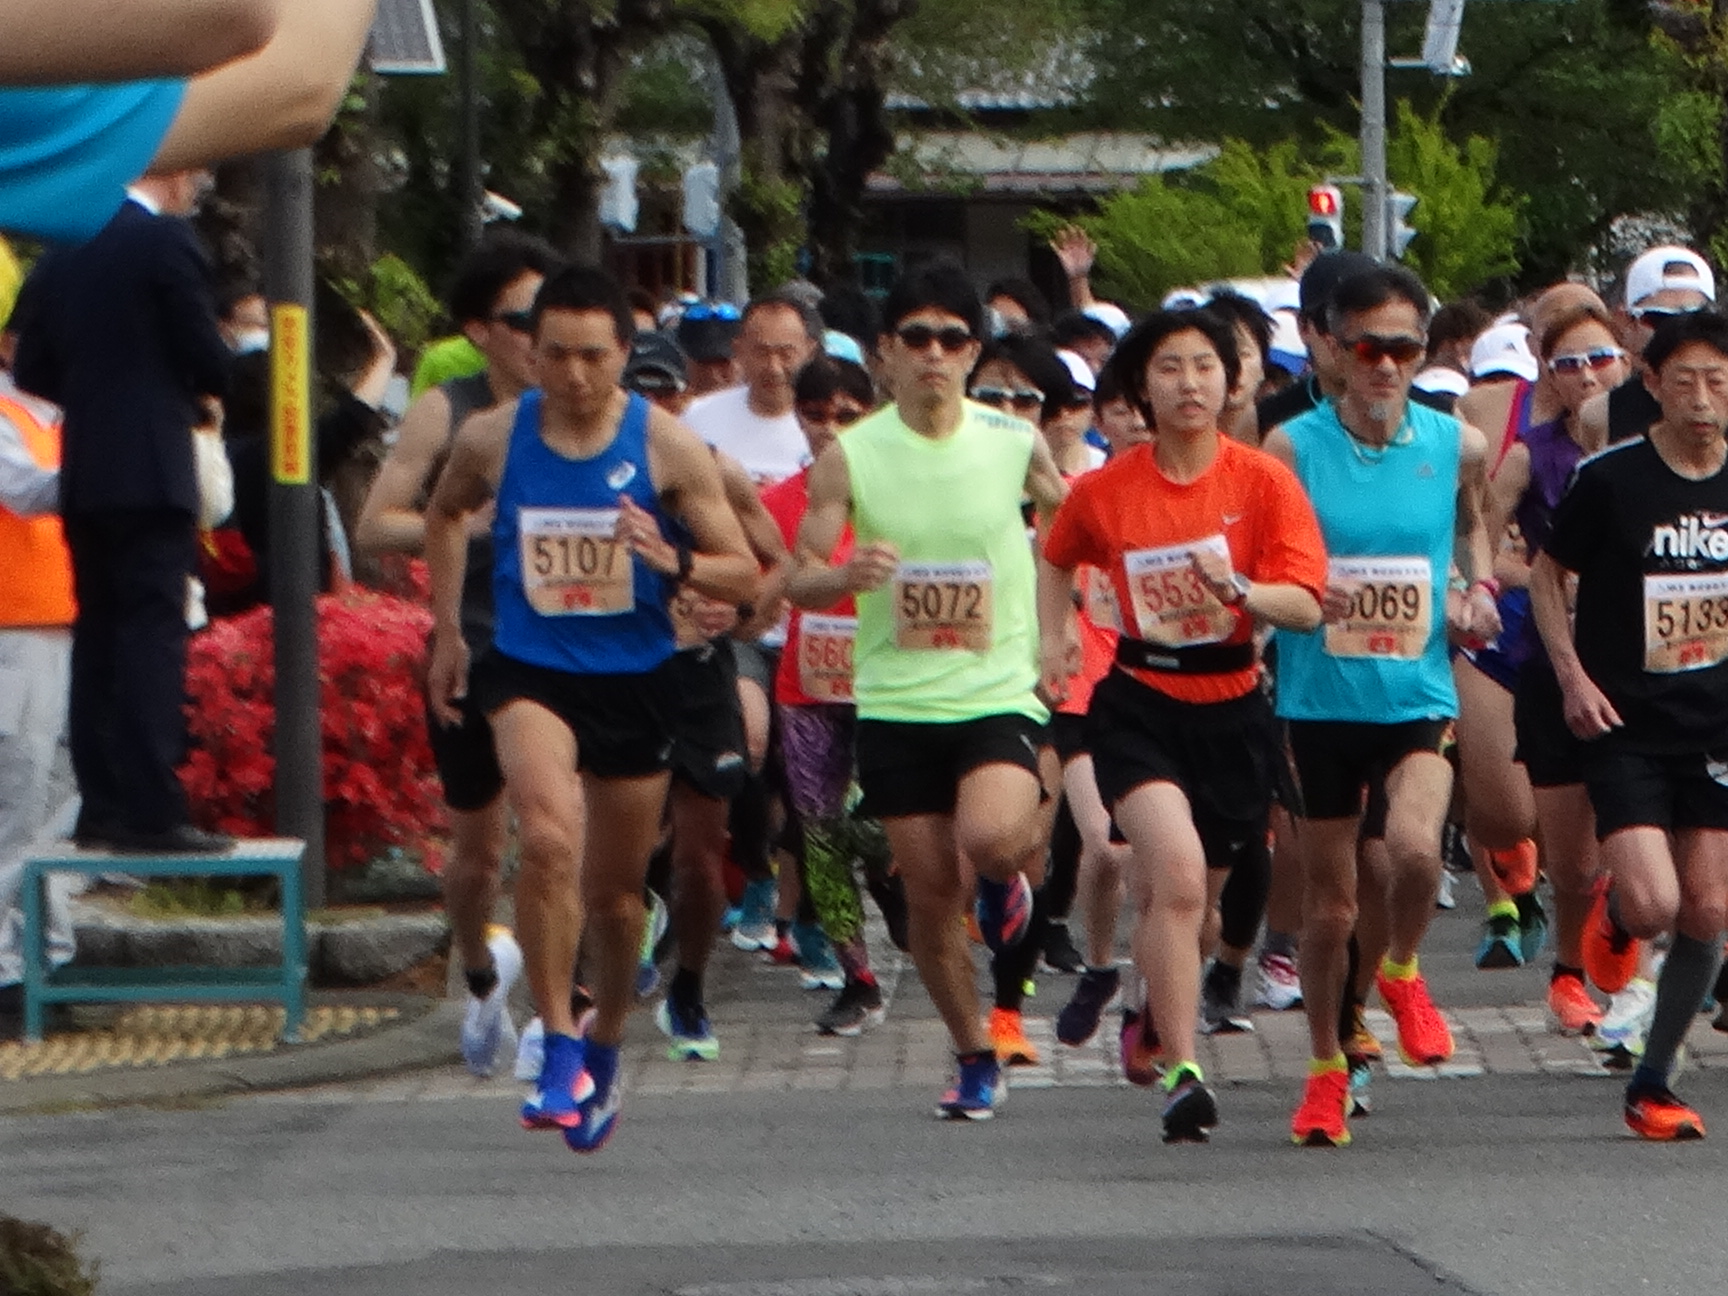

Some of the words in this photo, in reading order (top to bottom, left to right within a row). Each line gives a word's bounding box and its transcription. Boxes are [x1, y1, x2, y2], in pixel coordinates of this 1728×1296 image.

[534, 536, 617, 577] 5107
[902, 582, 982, 619] 5072
[1140, 568, 1206, 613] 553
[1344, 584, 1420, 621] 069
